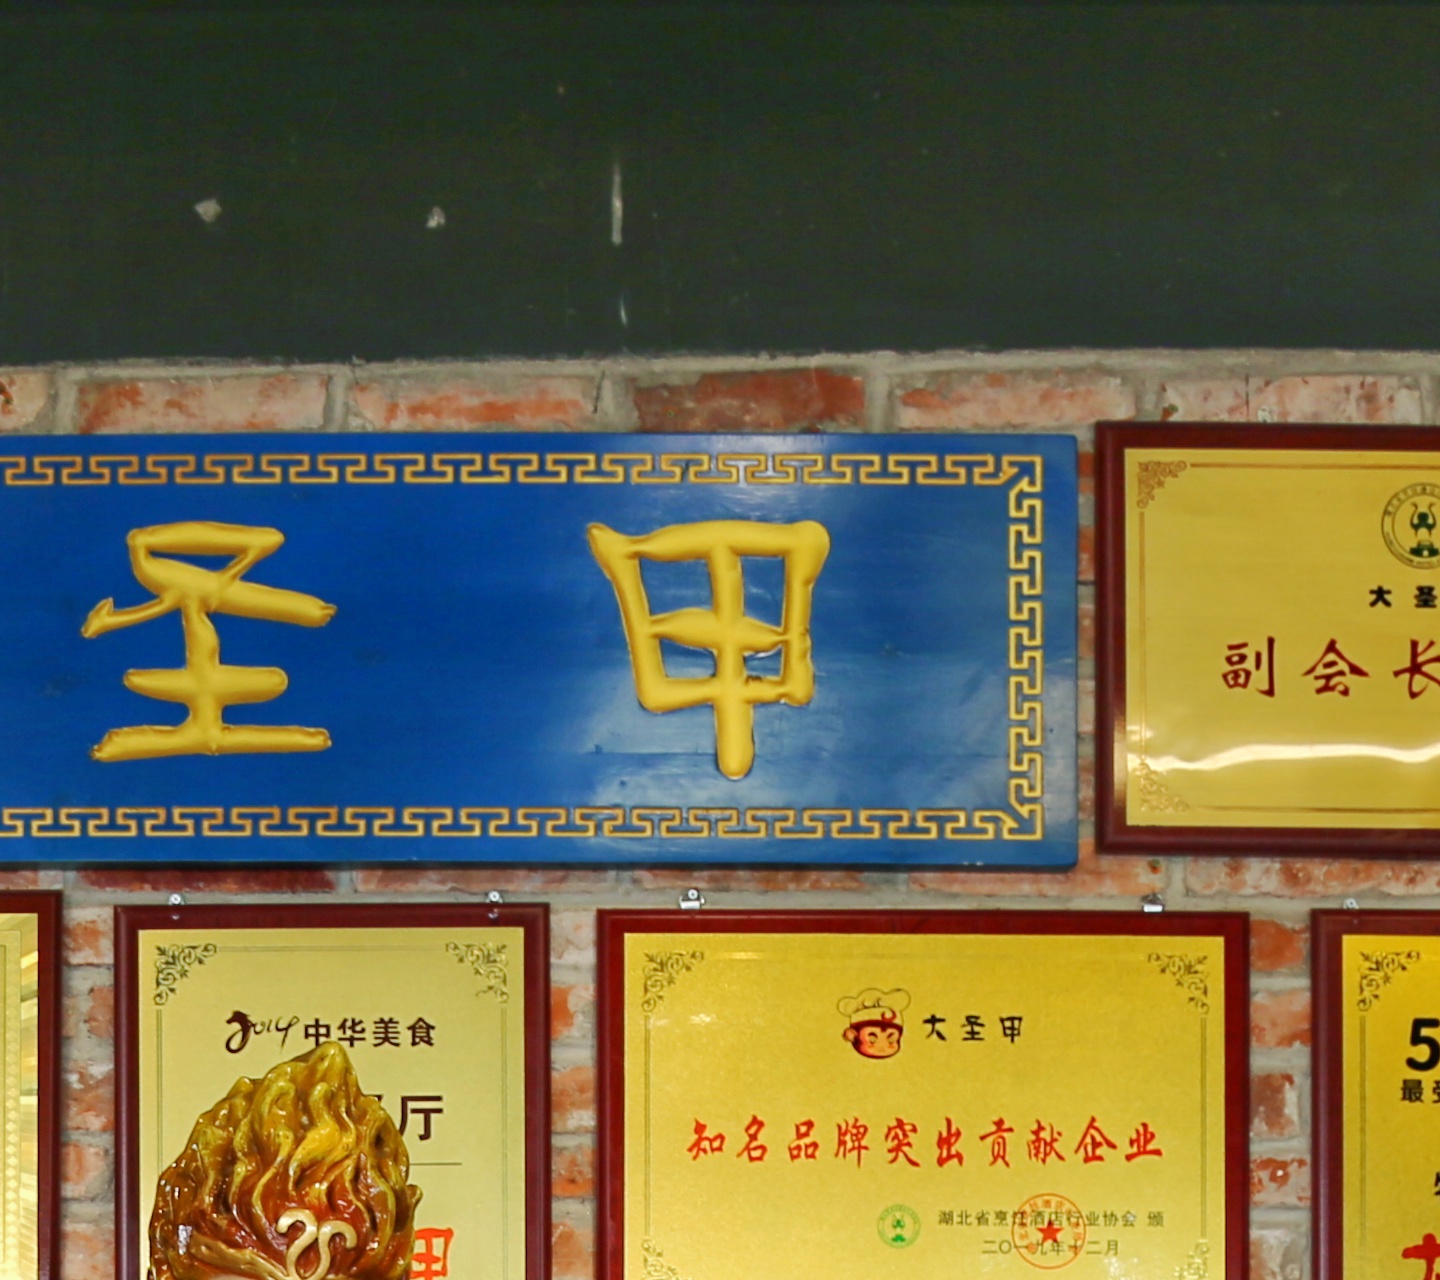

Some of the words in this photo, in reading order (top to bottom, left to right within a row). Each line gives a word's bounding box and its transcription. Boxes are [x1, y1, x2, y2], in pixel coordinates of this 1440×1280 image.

[302, 1016, 437, 1049] 中华美食
[923, 1014, 1024, 1044] 大圣甲
[686, 1114, 1164, 1169] 知名品牌突出贡献企业
[938, 1208, 1137, 1229] 湖北省烹饪酒店行业协会
